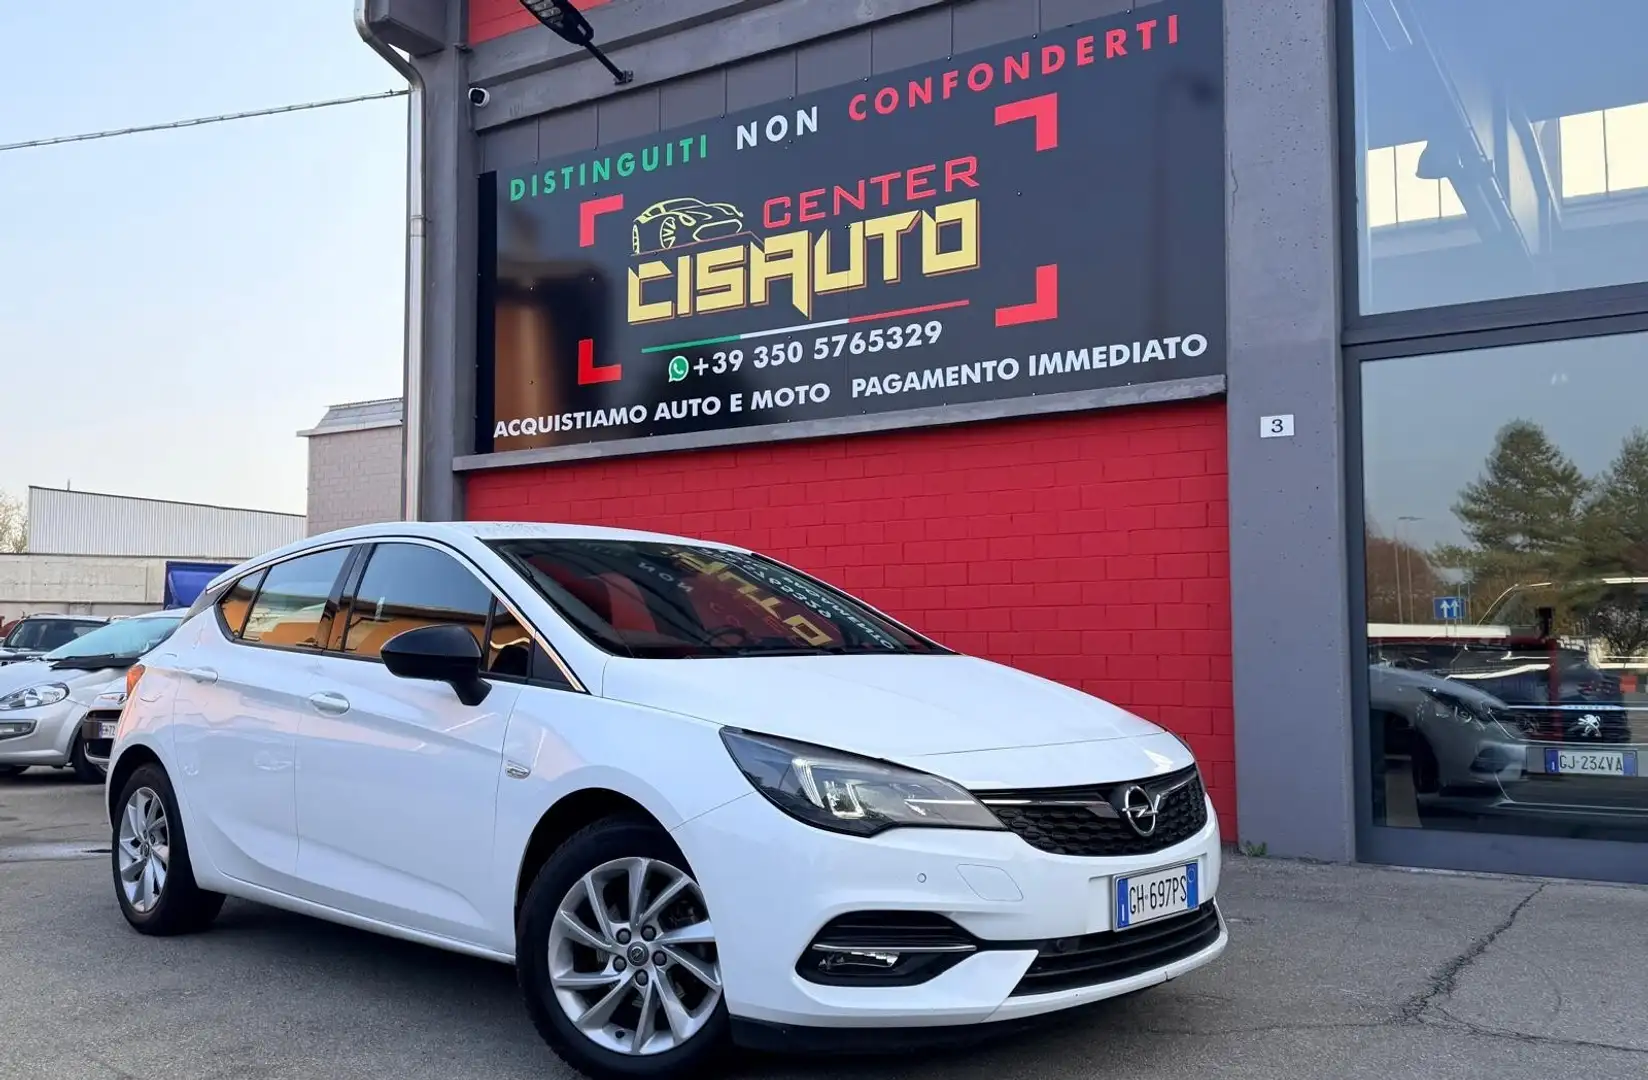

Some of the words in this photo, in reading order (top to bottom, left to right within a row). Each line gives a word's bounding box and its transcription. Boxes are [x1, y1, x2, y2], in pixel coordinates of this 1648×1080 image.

[510, 134, 708, 201] DISTINGUITI
[736, 106, 819, 151] NON
[848, 14, 1179, 121] CONFONDERTI
[763, 155, 980, 229] CENTER
[627, 198, 980, 326] CISAUTO
[493, 405, 648, 438] ACQUISTIAMO
[653, 396, 721, 421] AUTO
[729, 392, 743, 413] E
[750, 383, 831, 410] MOTO
[851, 357, 1020, 398] PAGAMENTO
[1028, 332, 1209, 377] IMMEDIATO
[693, 350, 744, 376] +39
[753, 340, 802, 366] 350
[813, 320, 943, 360] 5765329
[1271, 418, 1284, 433] 3
